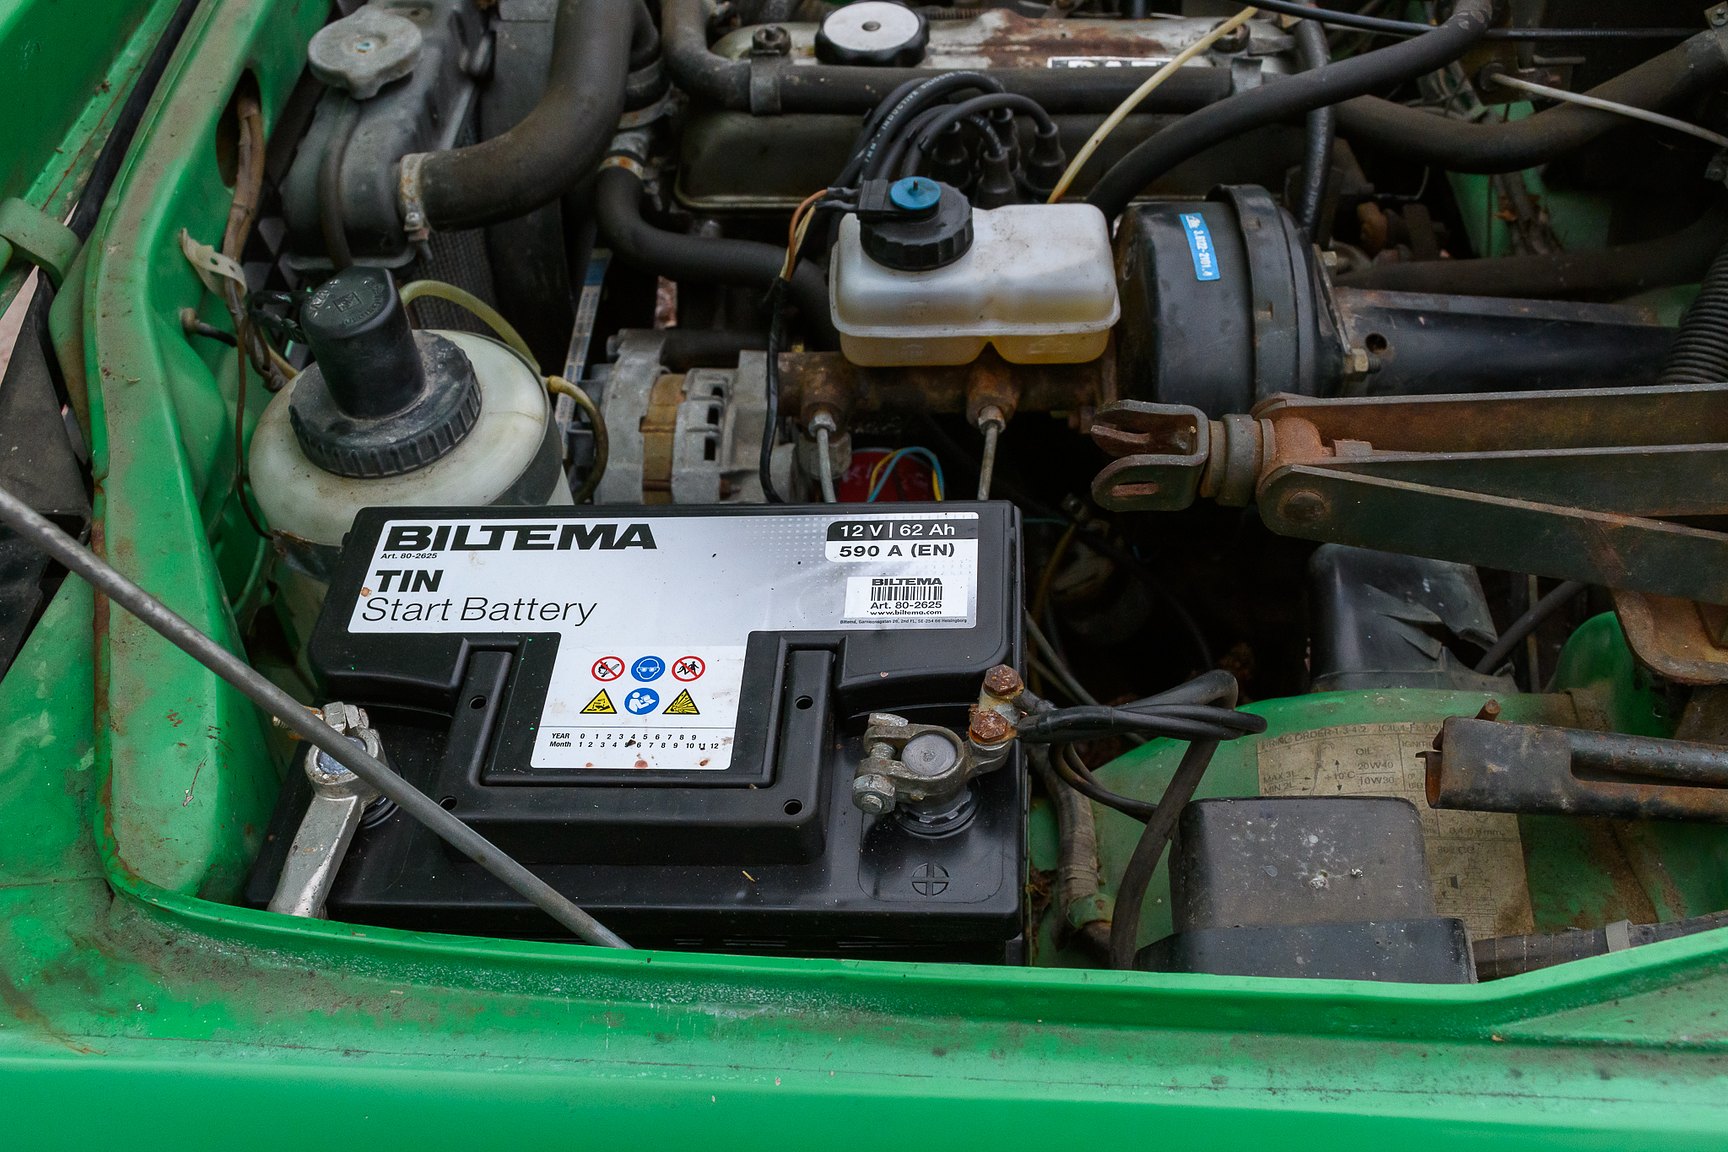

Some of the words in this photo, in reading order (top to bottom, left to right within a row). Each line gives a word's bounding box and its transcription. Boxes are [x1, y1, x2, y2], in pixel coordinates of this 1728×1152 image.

[840, 524, 864, 537] 12
[870, 524, 883, 537] V
[900, 523, 923, 536] 62
[929, 523, 955, 536] Ah
[383, 523, 658, 551] BILTEMA
[400, 552, 438, 560] 80-2625
[839, 545, 880, 557] 590
[888, 544, 903, 557] A
[911, 543, 955, 557] (EN)
[375, 569, 444, 592] TIN
[871, 577, 943, 586] BILTEMA
[362, 597, 453, 622] Start
[460, 597, 598, 626] Battery
[870, 601, 892, 610] Art.
[895, 601, 943, 609] 80-2625
[1356, 747, 1374, 756] OIL
[1358, 761, 1394, 771] 20W40
